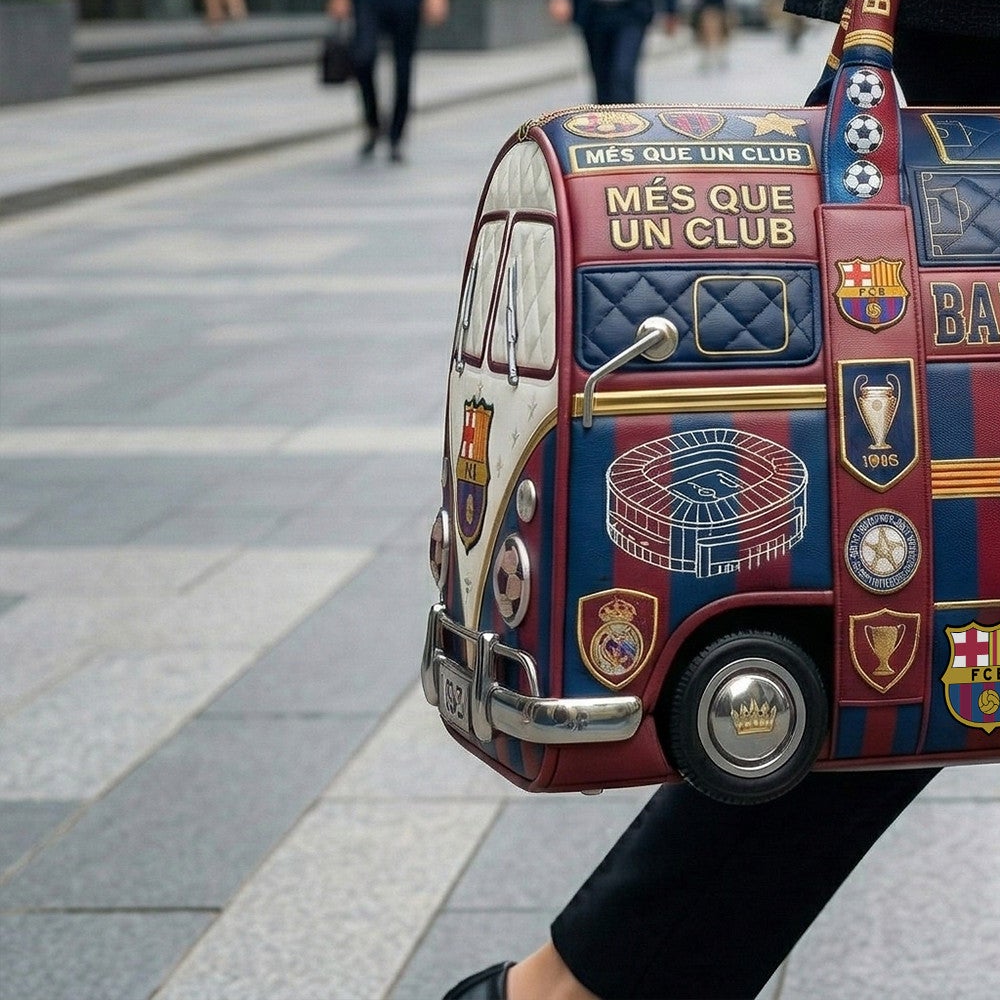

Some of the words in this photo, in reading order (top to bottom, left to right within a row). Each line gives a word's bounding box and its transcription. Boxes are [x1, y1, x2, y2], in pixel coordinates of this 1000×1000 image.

[585, 145, 634, 164] MÉS
[641, 145, 691, 163] QUE
[700, 145, 737, 162] UN
[741, 145, 802, 163] CLUB
[605, 176, 697, 215] MÉS
[704, 183, 796, 216] QUE
[609, 217, 673, 250] UN
[682, 216, 798, 249] CLUB
